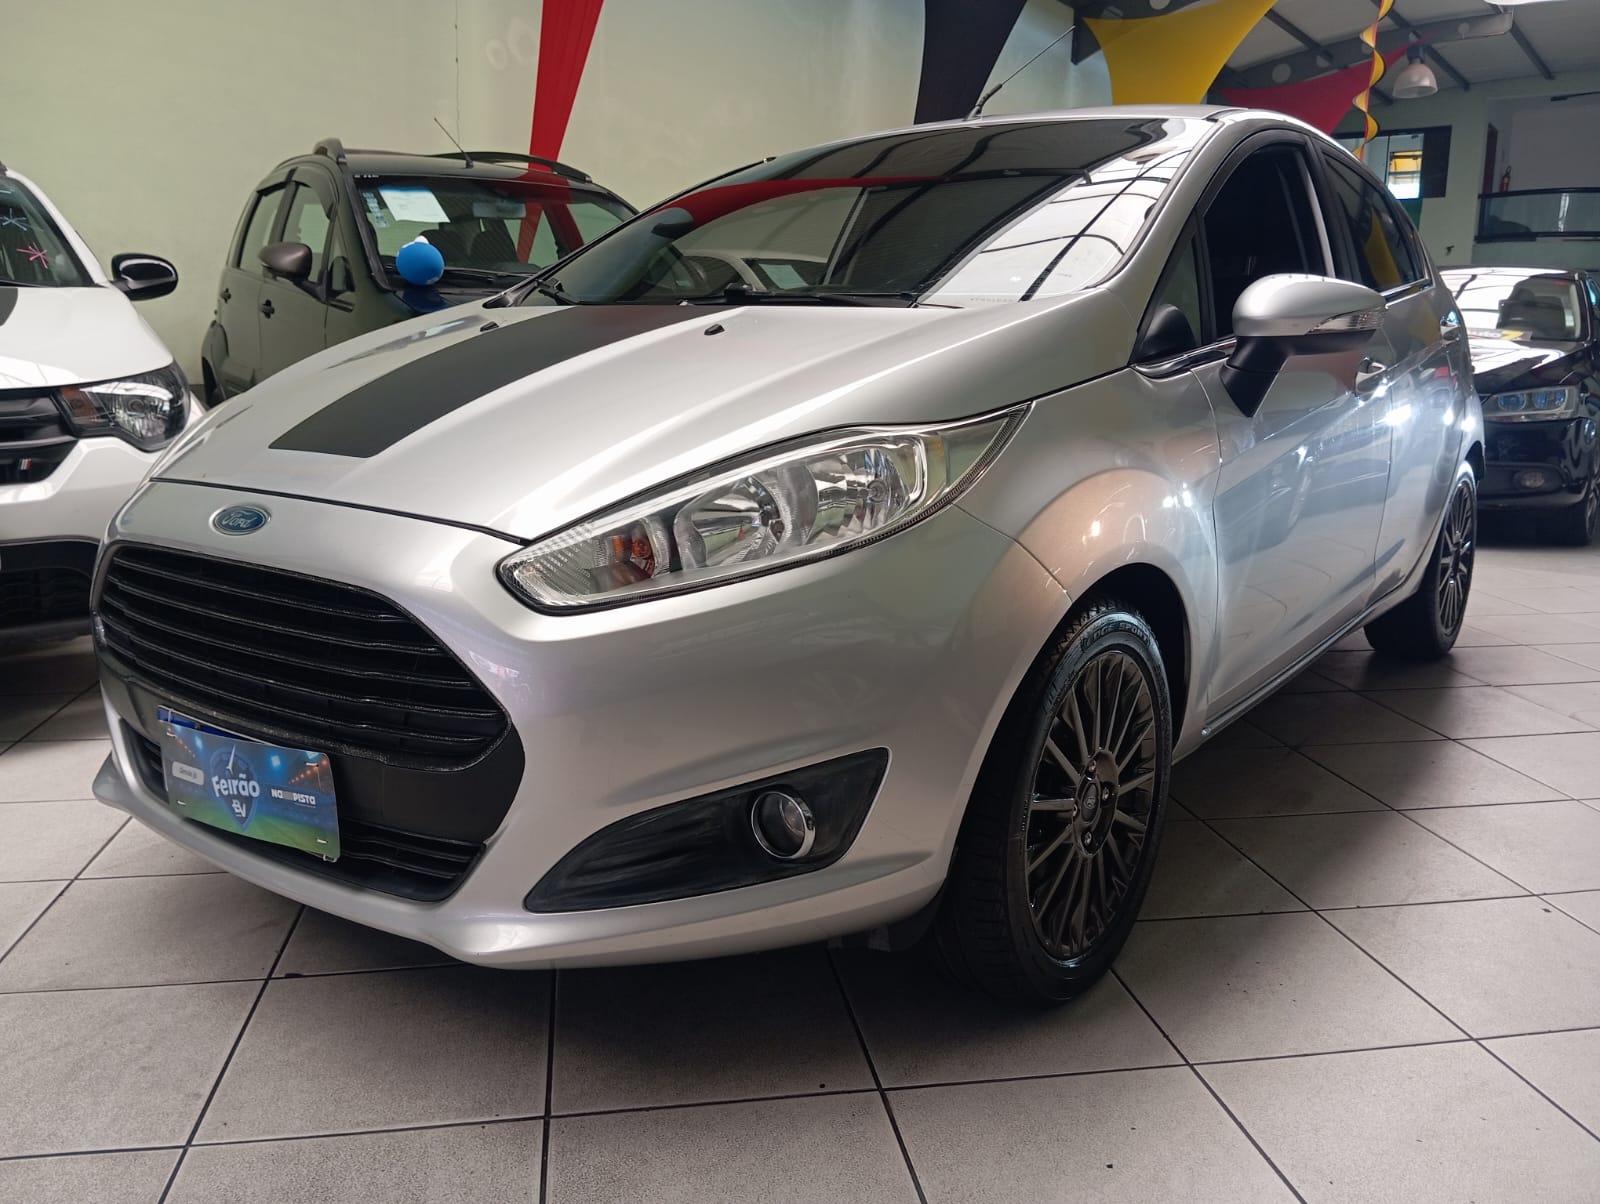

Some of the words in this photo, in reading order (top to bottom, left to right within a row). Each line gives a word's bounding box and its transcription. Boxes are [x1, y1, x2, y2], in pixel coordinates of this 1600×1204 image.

[221, 509, 258, 528] Ford
[212, 773, 260, 798] Feirão
[232, 799, 246, 817] BV
